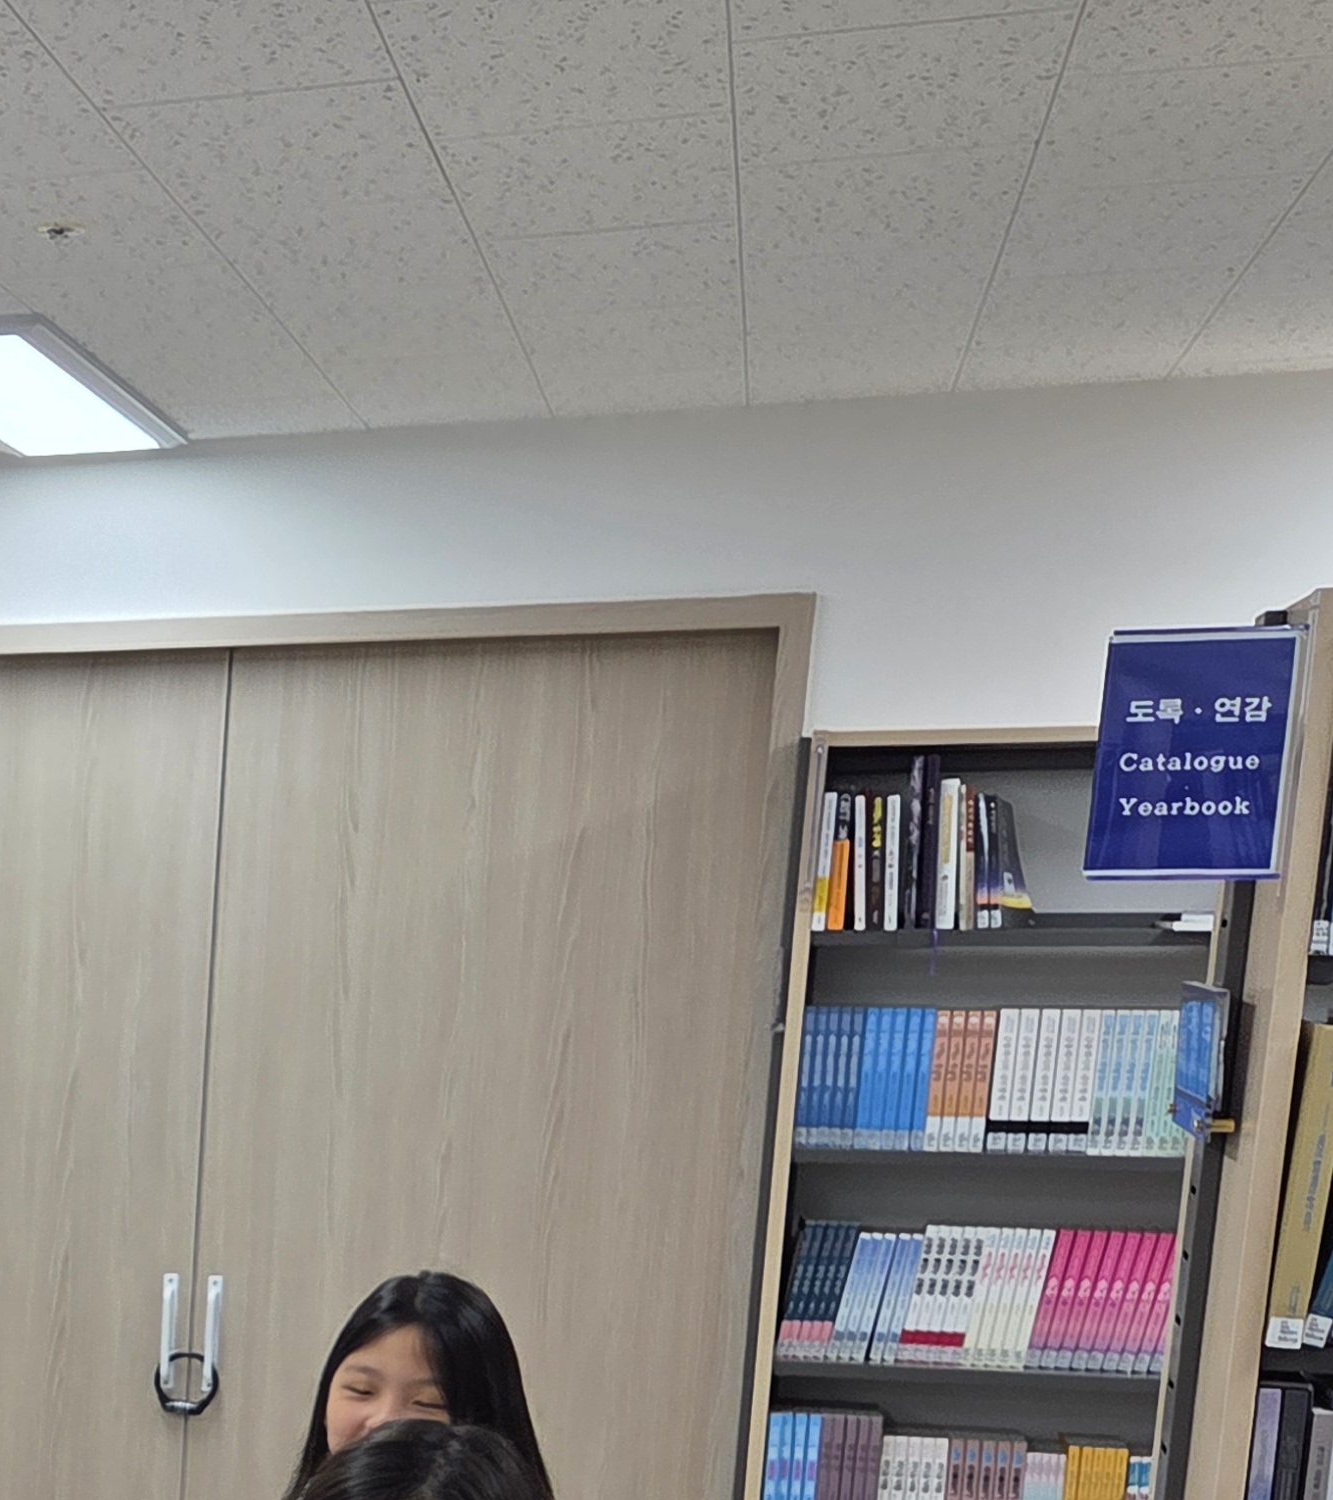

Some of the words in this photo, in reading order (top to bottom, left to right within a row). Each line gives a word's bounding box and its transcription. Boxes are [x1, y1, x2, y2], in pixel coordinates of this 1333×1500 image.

[1125, 697, 1184, 725] 도록
[1213, 695, 1273, 723] 연감
[1118, 751, 1261, 773] Catalogue
[1118, 795, 1251, 817] Yearbook
